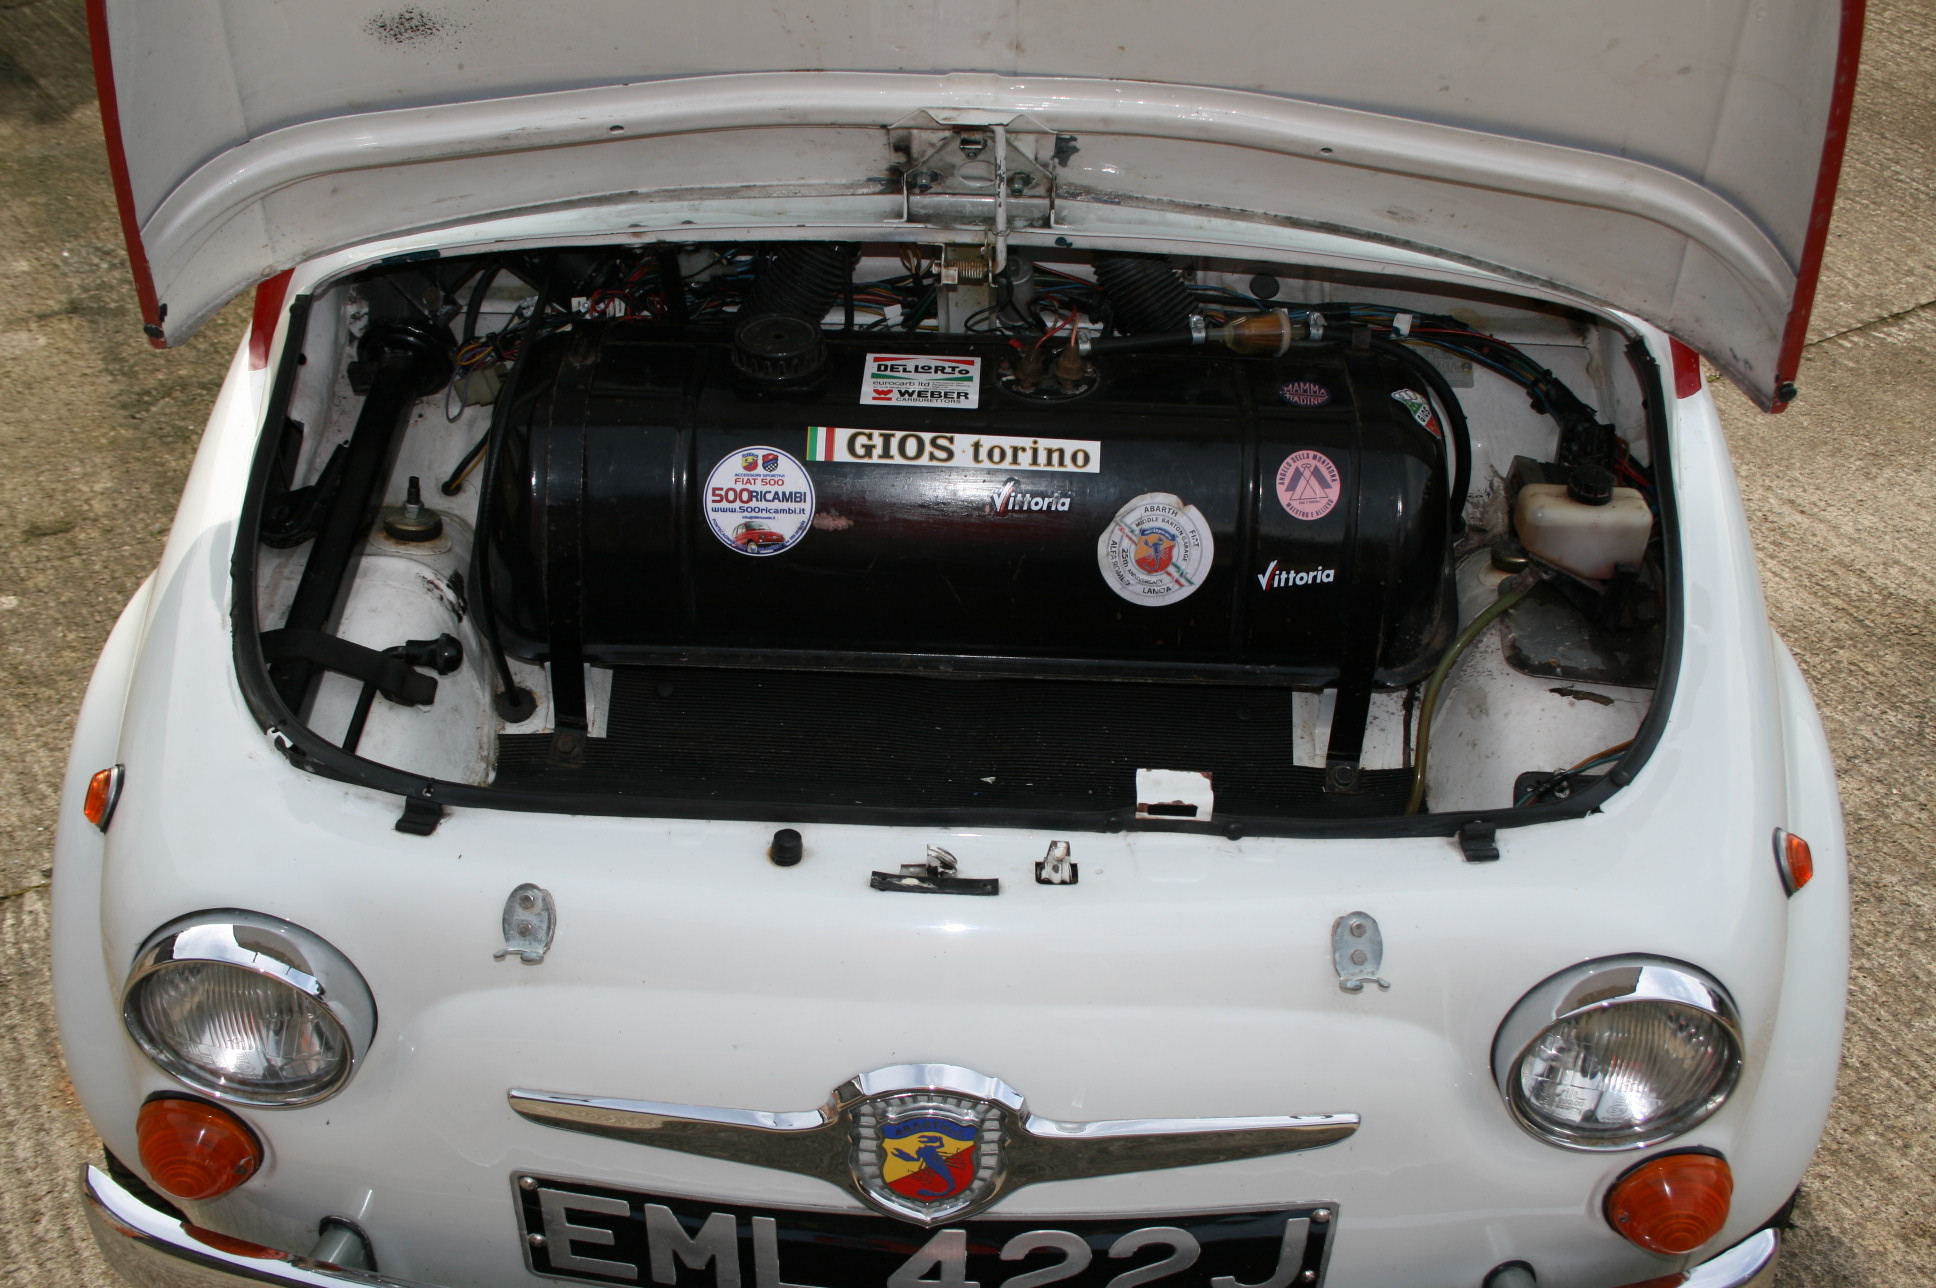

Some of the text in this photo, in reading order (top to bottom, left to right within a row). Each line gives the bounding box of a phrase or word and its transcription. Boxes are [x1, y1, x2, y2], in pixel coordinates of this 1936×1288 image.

[876, 363, 970, 375] DELLORTO
[897, 389, 970, 400] WEBER
[847, 431, 1091, 470] GIOS torino
[1278, 461, 1292, 486] ANGELO
[1290, 452, 1310, 464] DELLA
[734, 477, 785, 487] FIAT 500
[711, 487, 807, 505] 500RICAMBI
[990, 478, 1071, 517] Vittoria
[711, 505, 806, 515] www.500ricambi.it
[1144, 505, 1179, 517] ABARTH
[1286, 501, 1310, 518] MAESTRO
[1135, 516, 1160, 528] MIDDLE
[1161, 517, 1184, 536] BARTON
[1181, 535, 1189, 562] GARAGE
[1188, 529, 1200, 548] FIAT
[1109, 539, 1118, 560] ALFA
[1121, 548, 1129, 568] 25th
[1257, 560, 1335, 591] Vittoria
[538, 1188, 820, 1288] EML
